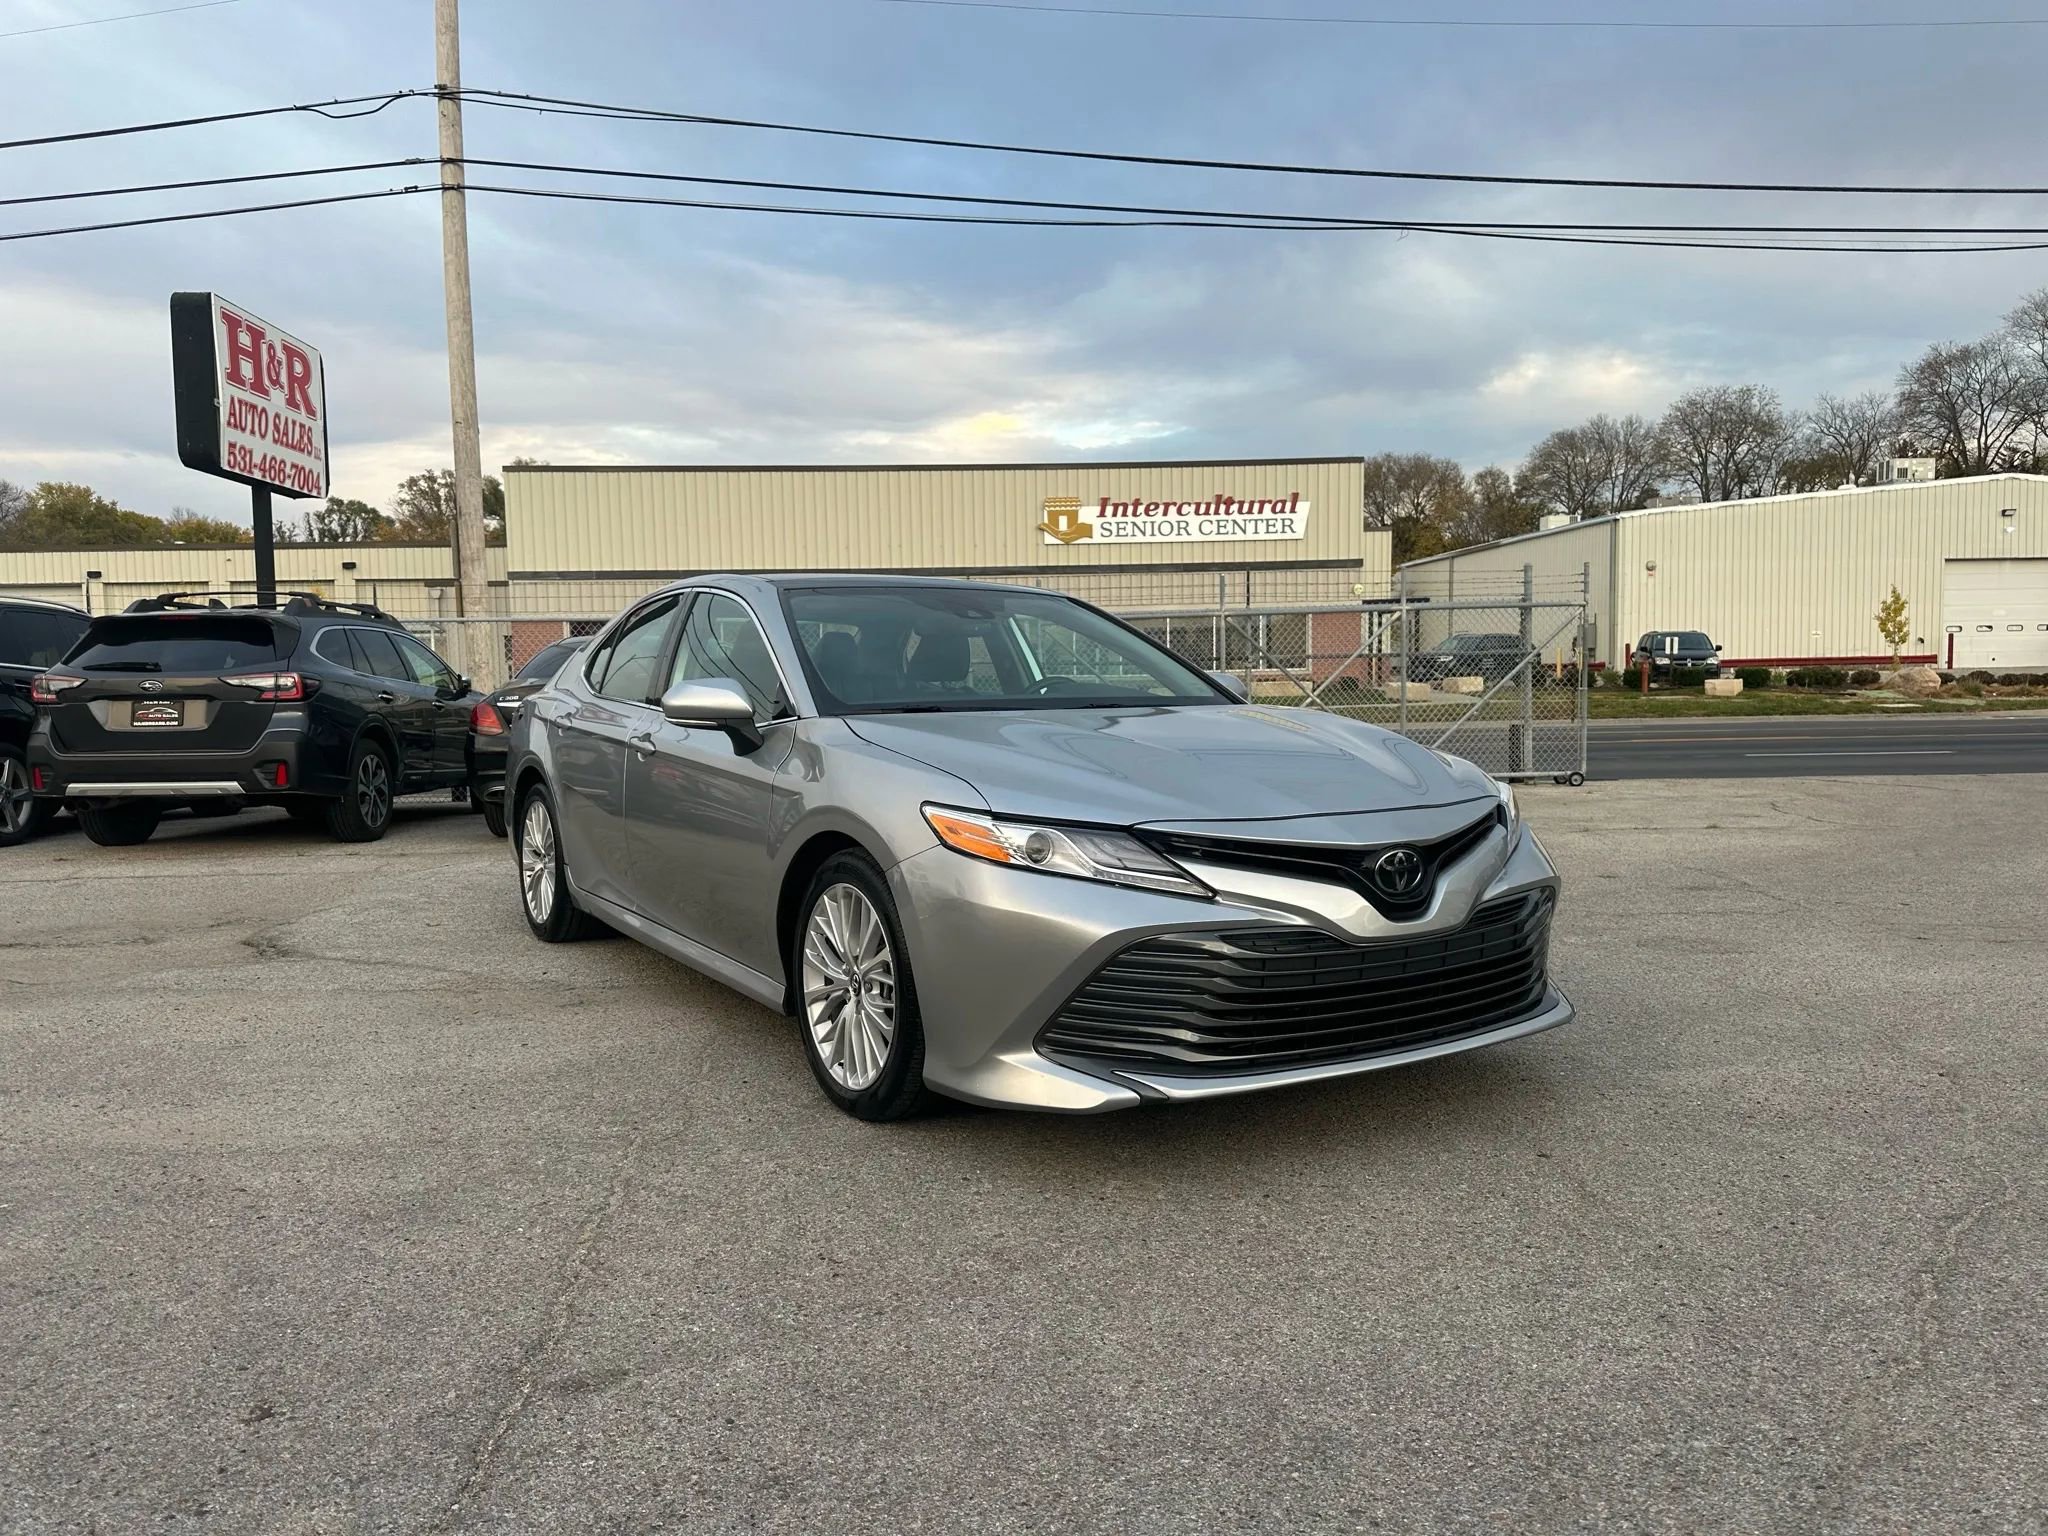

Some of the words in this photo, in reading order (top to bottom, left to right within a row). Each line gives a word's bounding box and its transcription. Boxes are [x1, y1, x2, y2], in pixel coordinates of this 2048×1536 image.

[220, 306, 317, 421] H&R
[227, 394, 269, 441] AUTO
[272, 411, 313, 456] SALES
[227, 440, 321, 496] 531-466-7004
[1096, 492, 1299, 518] Intercultural
[1100, 520, 1191, 538] SENIOR
[1198, 518, 1296, 536] CENTER
